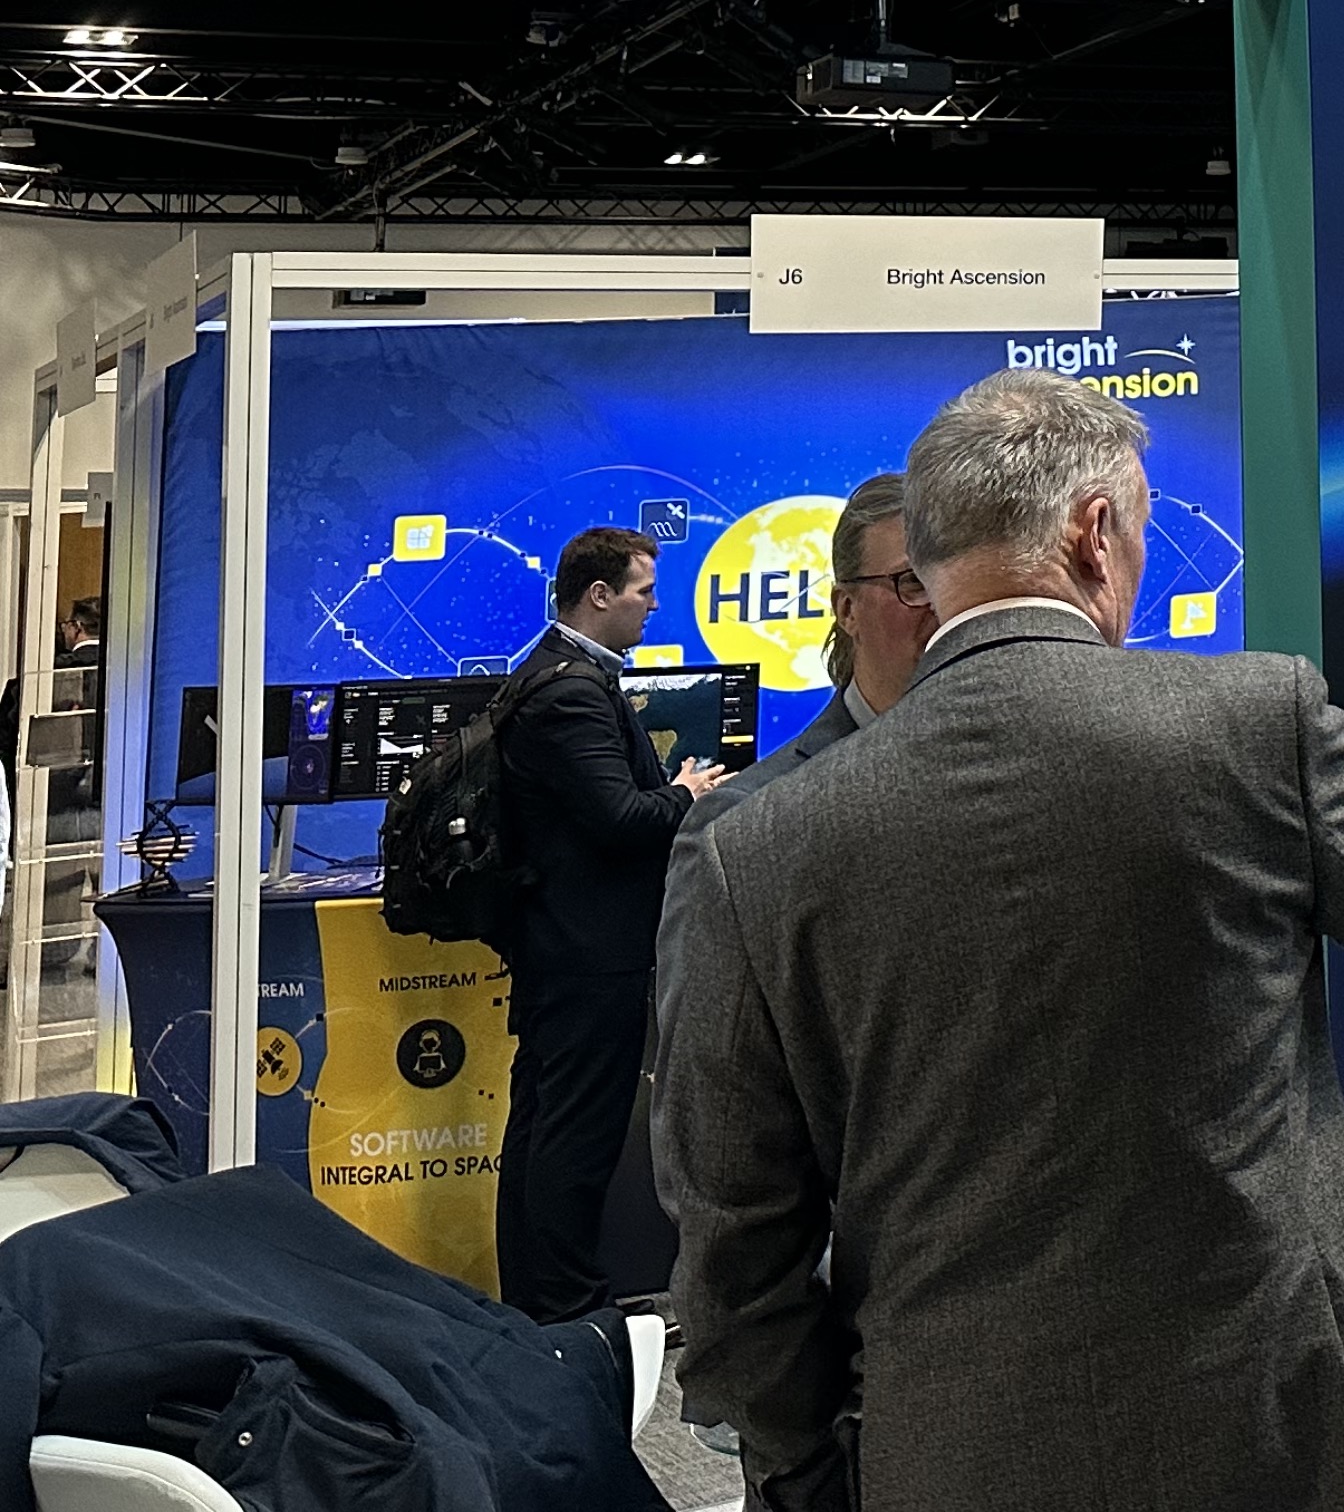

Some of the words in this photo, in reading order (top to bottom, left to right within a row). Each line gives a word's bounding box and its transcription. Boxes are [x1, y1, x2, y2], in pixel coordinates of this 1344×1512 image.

[778, 268, 803, 285] J6
[887, 268, 945, 289] Bright
[950, 268, 1045, 285] Ascension
[1007, 335, 1118, 375] bright
[709, 570, 834, 623] HEL
[379, 972, 477, 992] MIDSTREAM
[349, 1123, 487, 1158] SOFTWARE
[321, 1162, 414, 1186] INTEGRAL
[420, 1158, 448, 1179] TO
